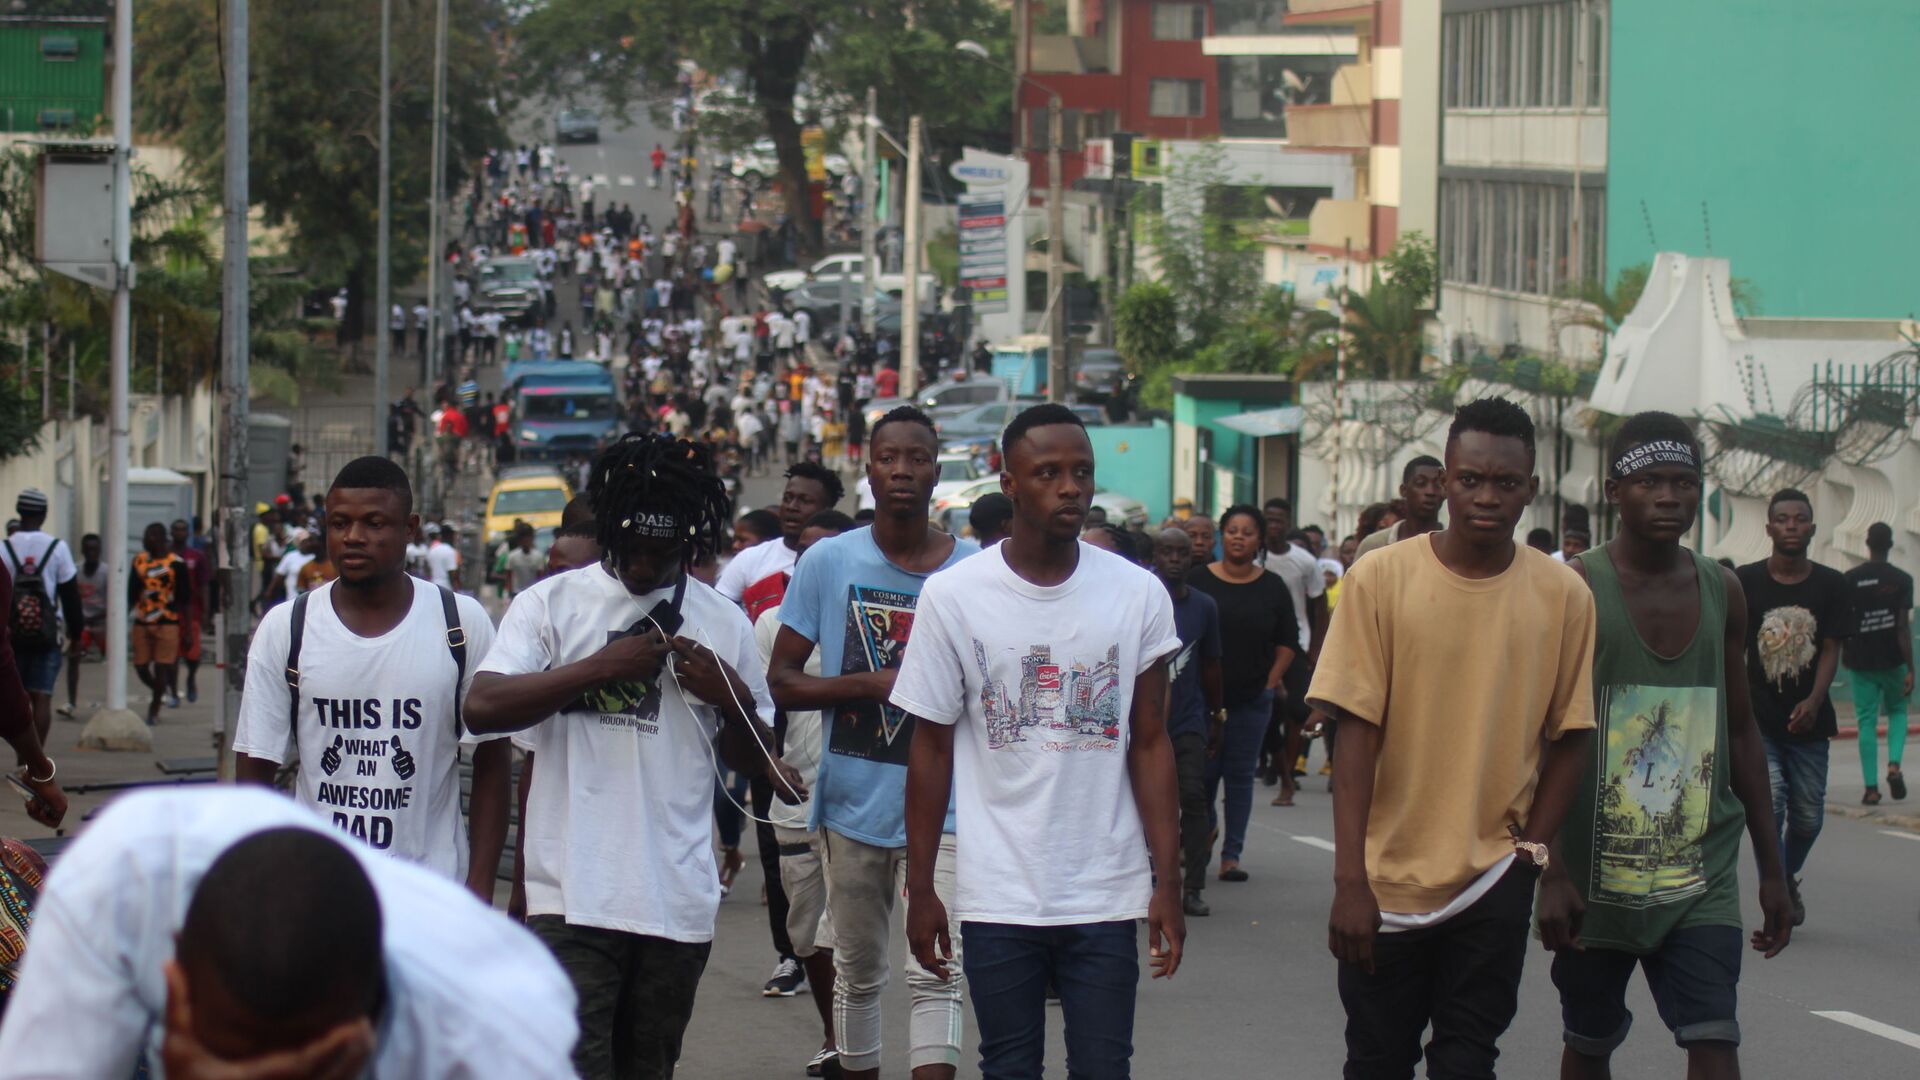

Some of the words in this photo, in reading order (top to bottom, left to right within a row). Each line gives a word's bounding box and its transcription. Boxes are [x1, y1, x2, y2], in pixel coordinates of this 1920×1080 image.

[1621, 466, 1631, 477] JE
[1631, 455, 1654, 471] SUIS
[634, 511, 677, 528] DAIS
[635, 526, 649, 535] JE
[873, 591, 907, 601] COSMIC
[312, 697, 382, 730] THIS
[393, 698, 423, 730] IS
[600, 715, 626, 726] HOUON
[344, 739, 390, 757] WHAT
[356, 760, 377, 777] AN
[317, 782, 412, 811] AWESOME
